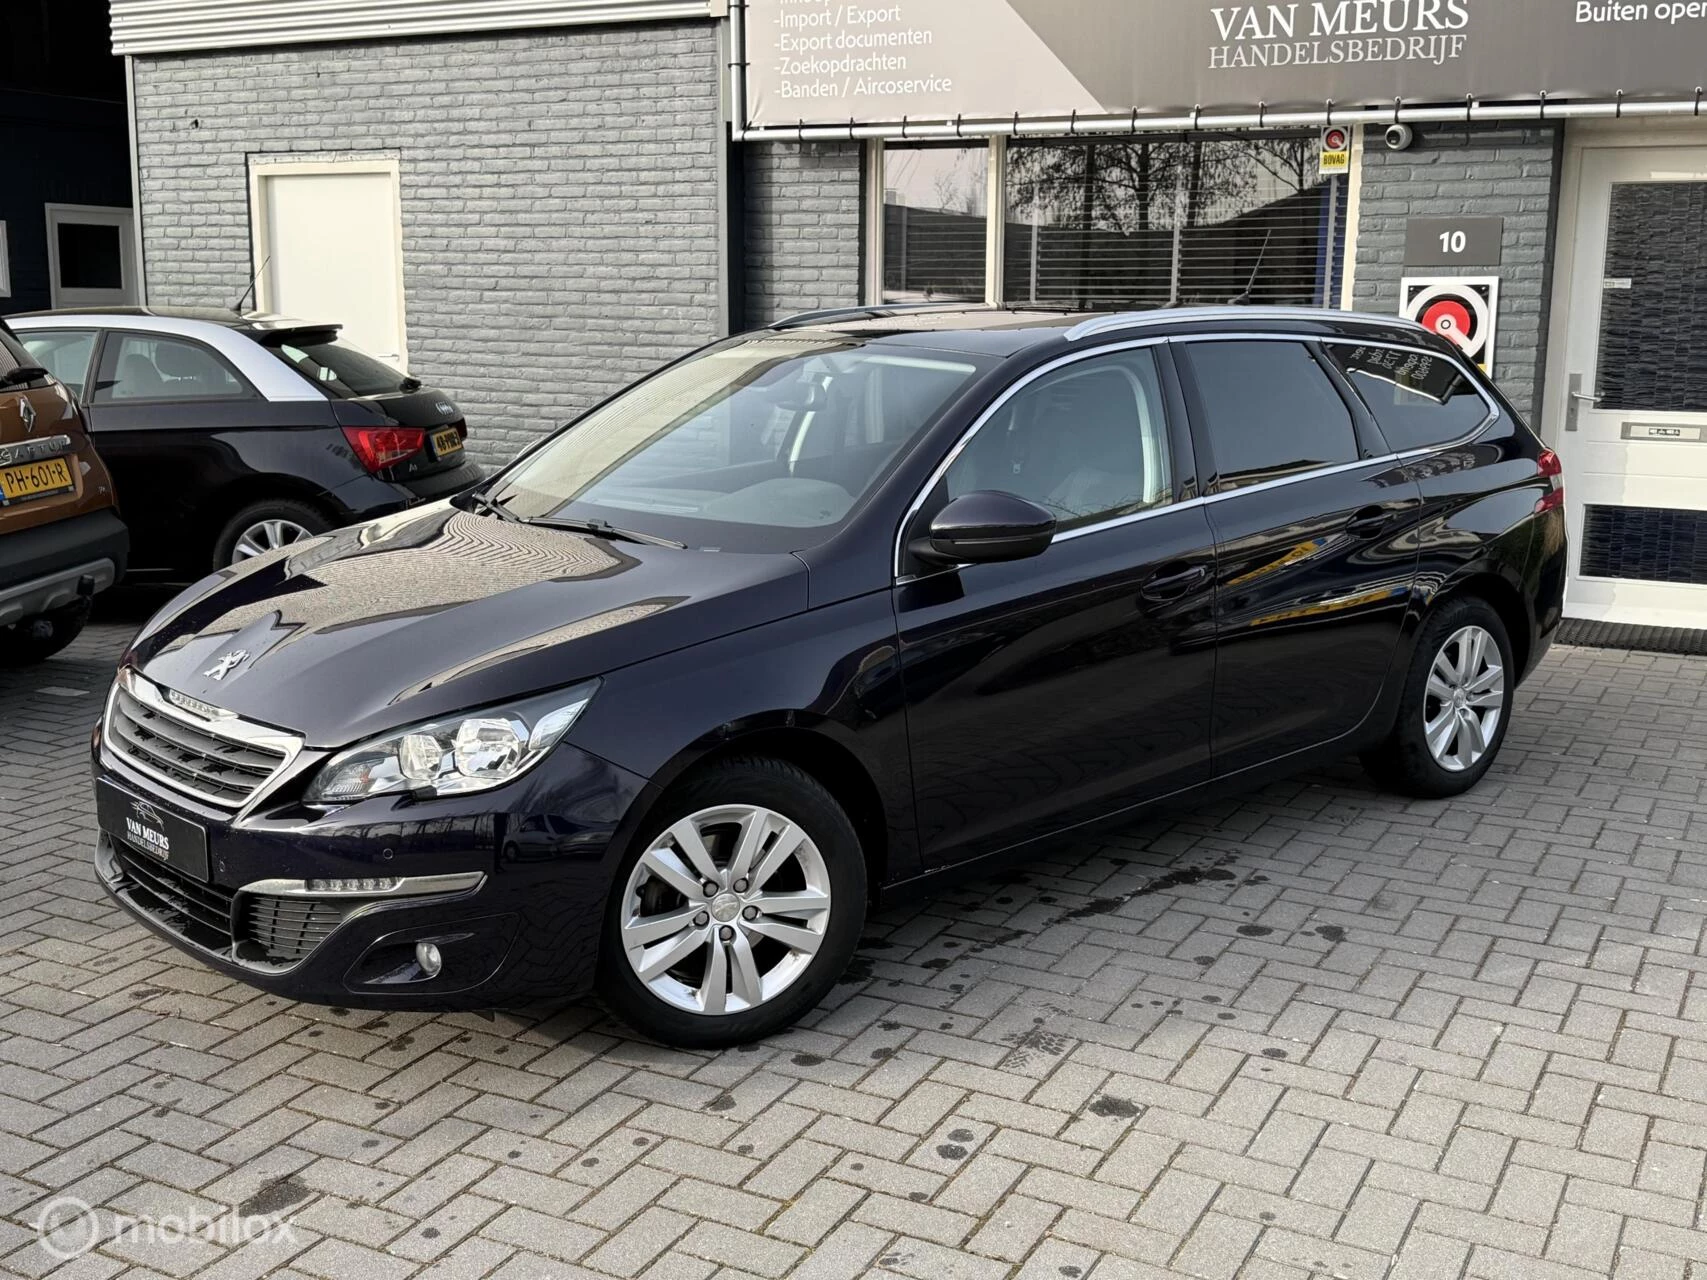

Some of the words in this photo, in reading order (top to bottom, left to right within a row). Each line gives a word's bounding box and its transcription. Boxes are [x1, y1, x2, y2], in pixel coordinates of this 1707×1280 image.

[773, 9, 832, 32] -Import
[847, 5, 901, 28] Export
[1210, 3, 1298, 41] VAN
[1309, 0, 1469, 36] MEURS
[1576, 0, 1648, 22] Buiten
[774, 33, 833, 56] -Export
[835, 28, 933, 49] documenten
[1208, 34, 1468, 69] HANDELSBEDRIJF
[773, 52, 907, 78] -Zoekopdrachten
[774, 79, 839, 98] -Banden
[853, 74, 953, 96] Aircoservice
[1323, 153, 1345, 166] BOVAG
[1438, 230, 1467, 254] 10
[4, 462, 68, 494] PH-601-R
[126, 816, 142, 837] VAN
[142, 825, 170, 850] MEURS
